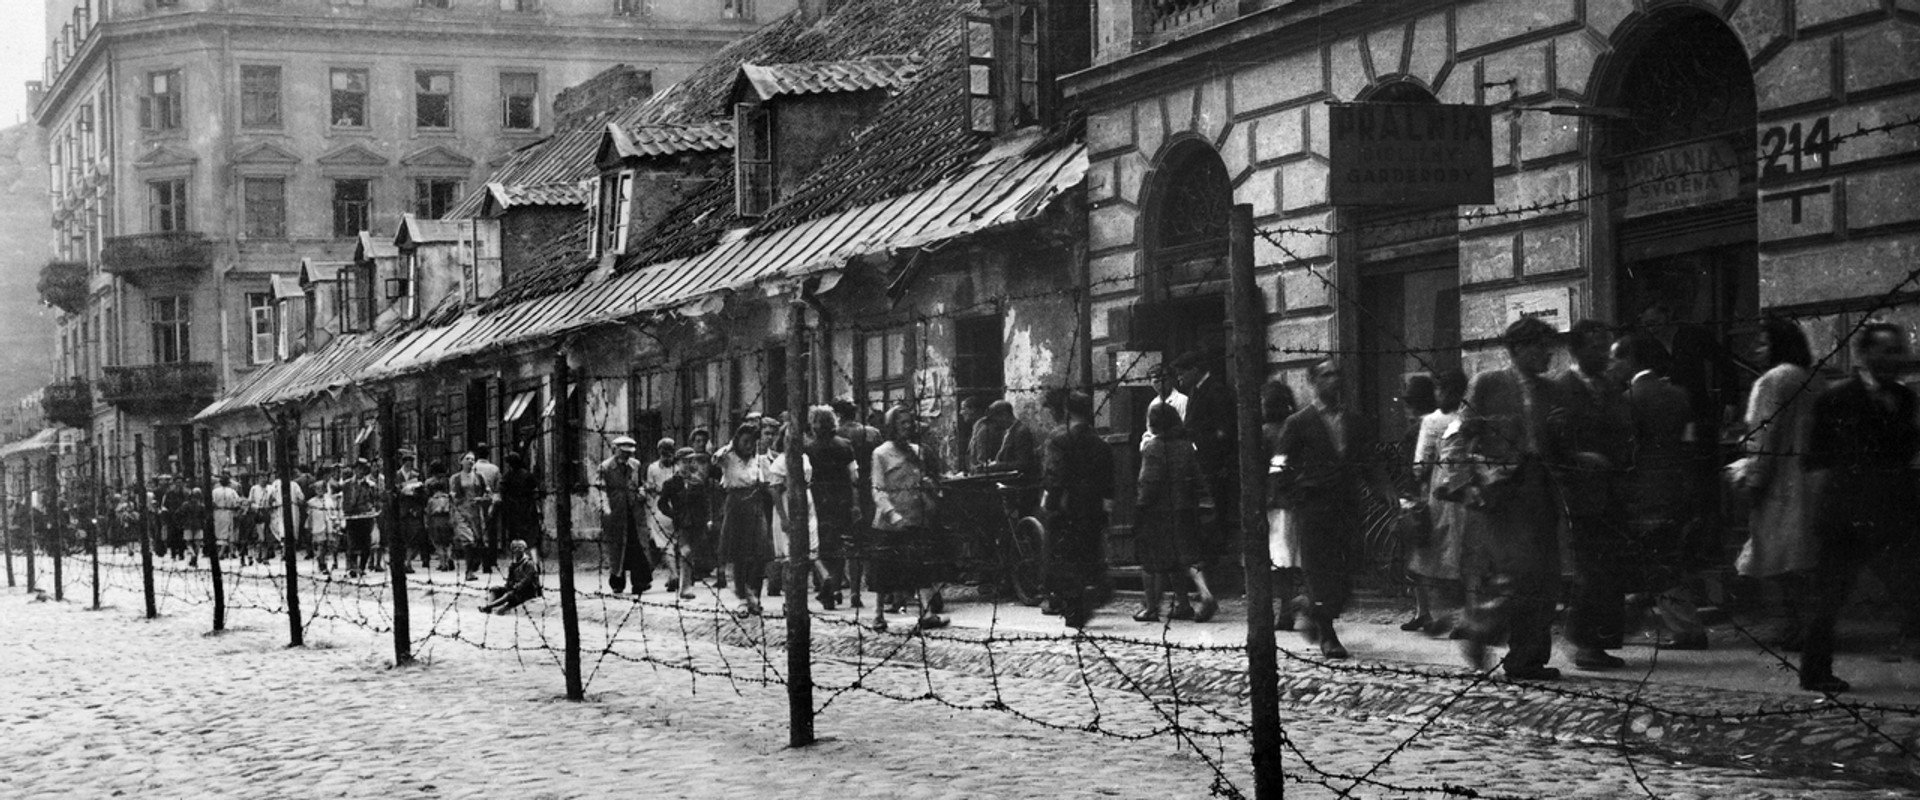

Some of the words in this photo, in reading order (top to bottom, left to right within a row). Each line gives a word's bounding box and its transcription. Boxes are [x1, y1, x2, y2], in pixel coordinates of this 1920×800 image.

[1337, 104, 1485, 141] PRALNIA
[1760, 117, 1830, 178] 214
[1347, 168, 1473, 184] GARDEROBY
[1762, 185, 1830, 224] T
